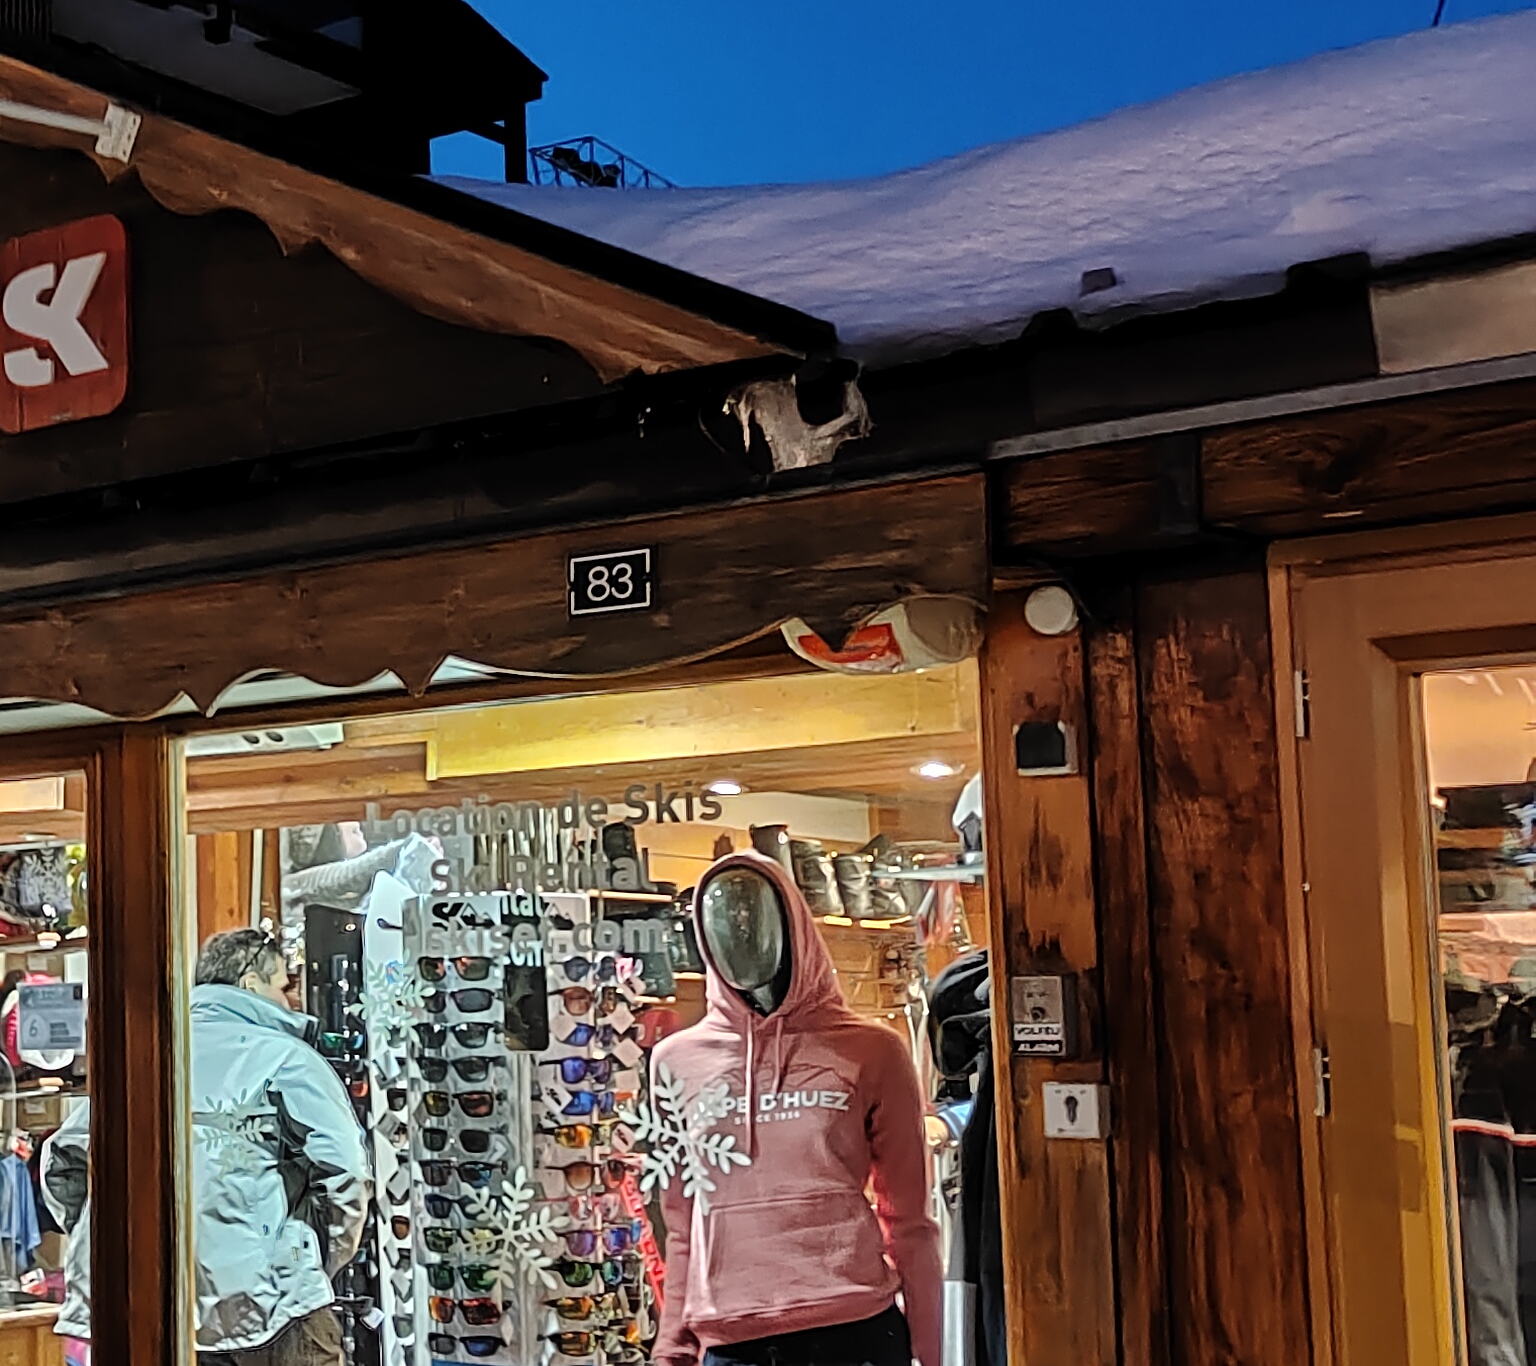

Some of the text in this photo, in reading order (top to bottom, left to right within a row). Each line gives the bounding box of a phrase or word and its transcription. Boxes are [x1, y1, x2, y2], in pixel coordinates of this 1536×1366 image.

[586, 562, 634, 602] 83
[365, 781, 723, 836] Location de Skis
[508, 847, 659, 894] Rental
[425, 914, 666, 957] skiset.com
[759, 1089, 851, 1112] D'HUEZ
